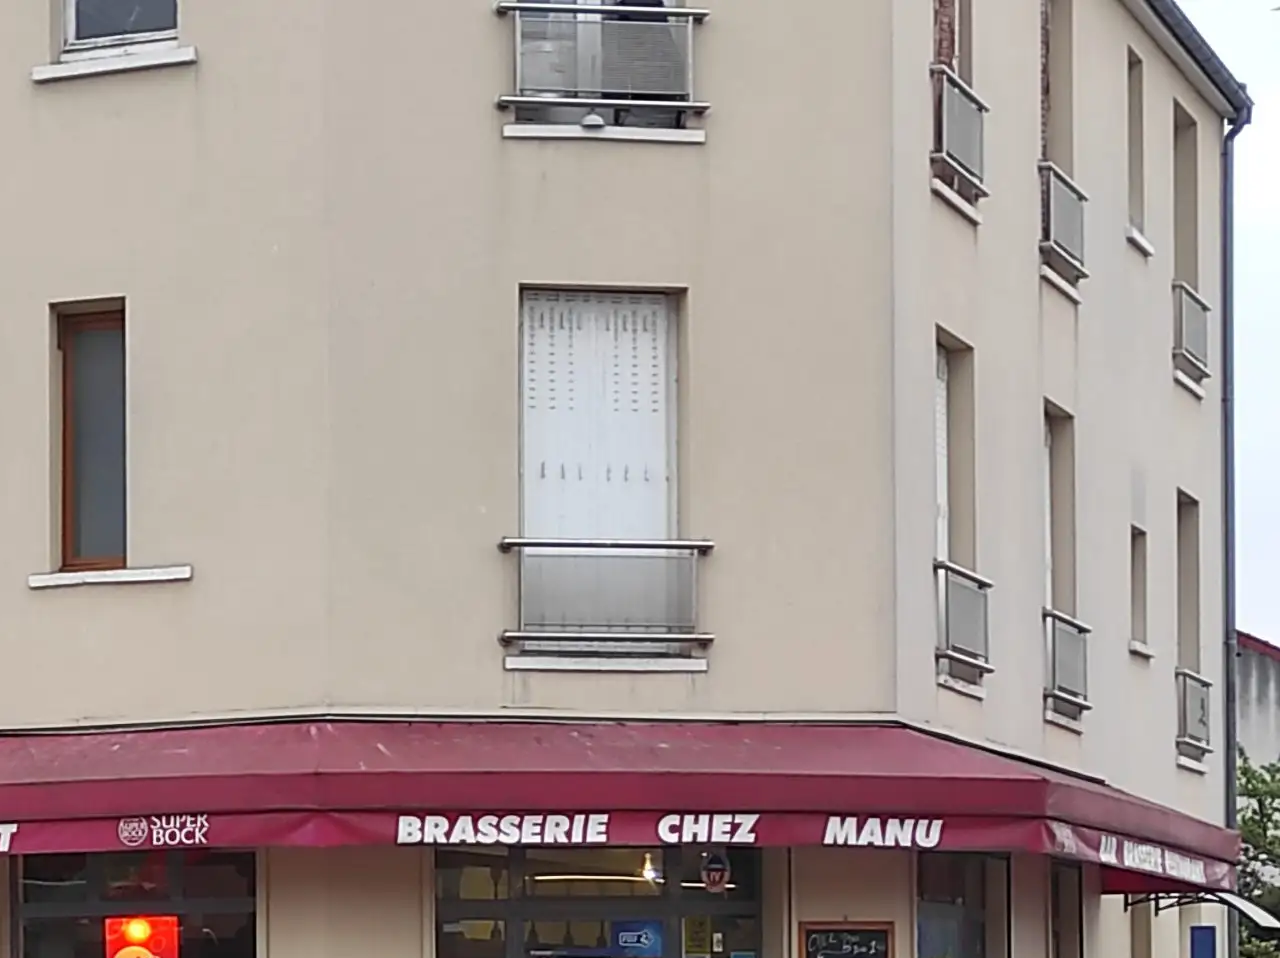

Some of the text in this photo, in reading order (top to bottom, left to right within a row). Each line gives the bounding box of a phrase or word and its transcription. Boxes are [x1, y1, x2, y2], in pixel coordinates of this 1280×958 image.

[152, 827, 208, 845] BOCK
[397, 813, 943, 847] BRASSERIE CHEZ MANU
